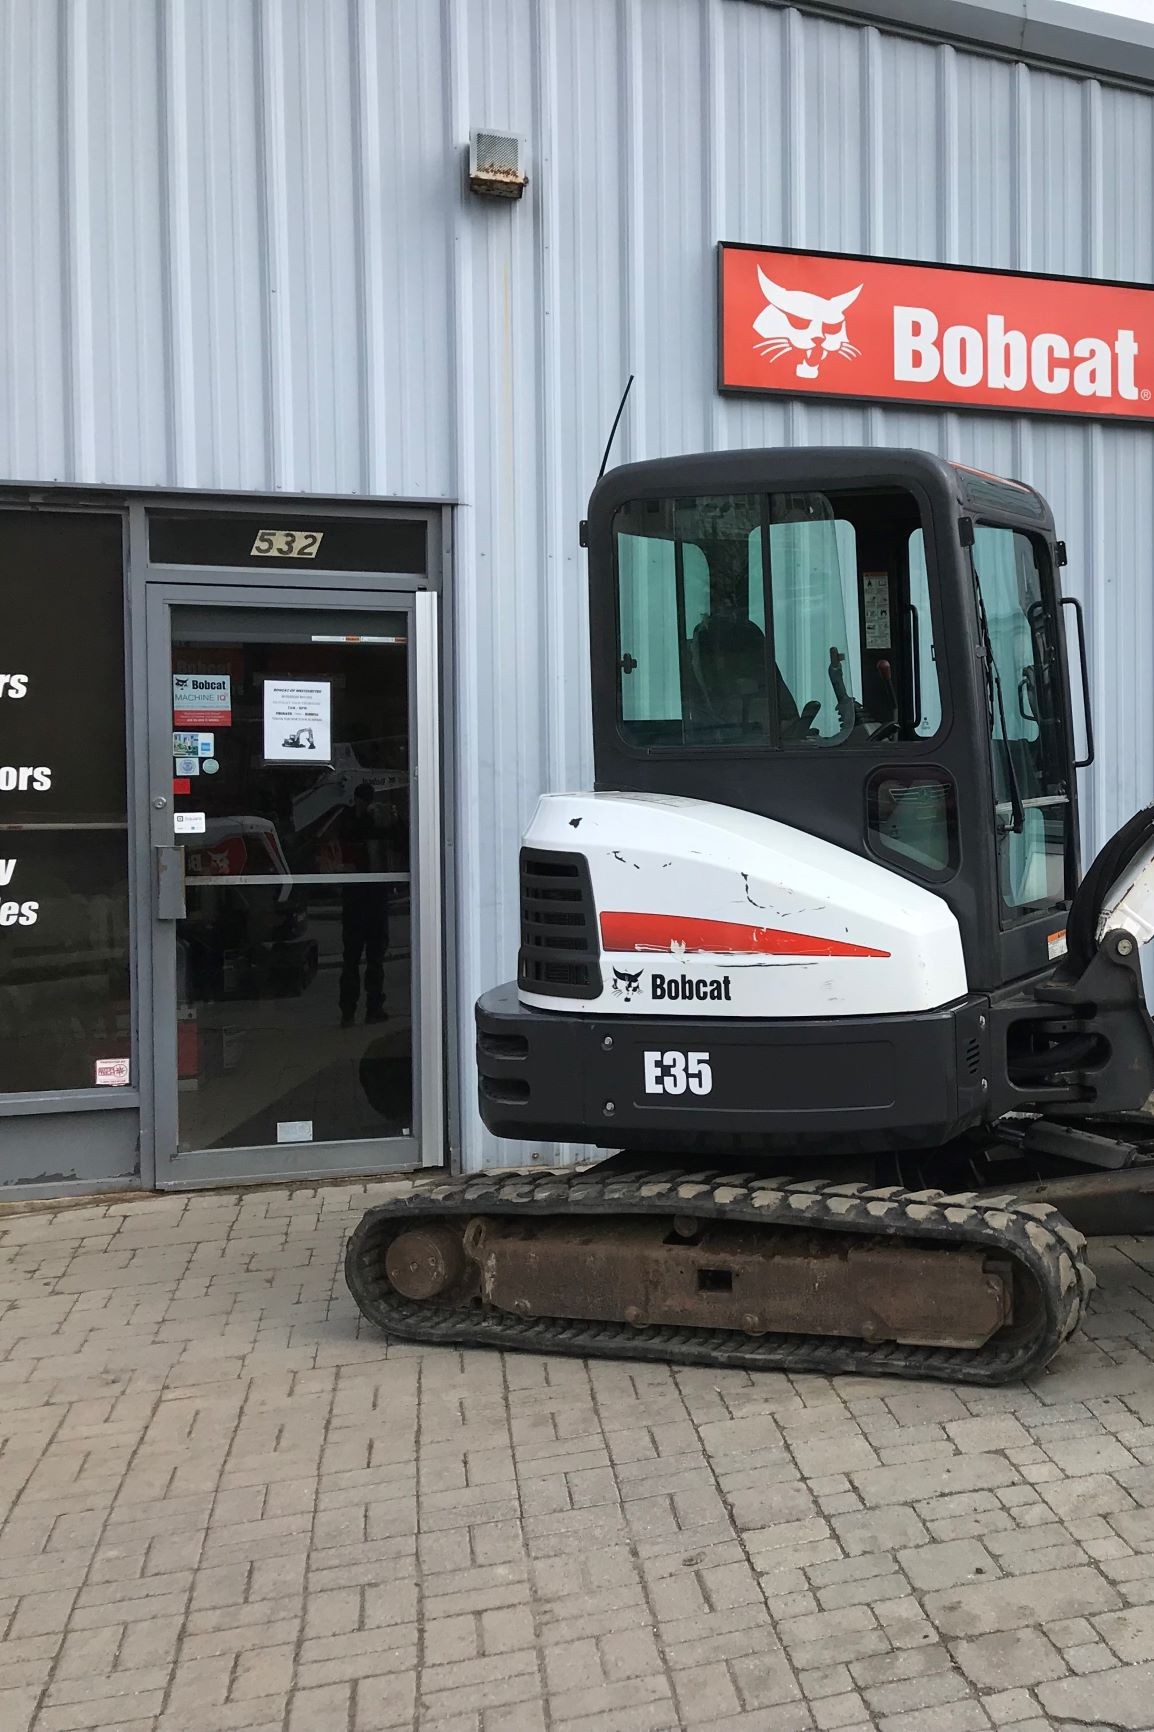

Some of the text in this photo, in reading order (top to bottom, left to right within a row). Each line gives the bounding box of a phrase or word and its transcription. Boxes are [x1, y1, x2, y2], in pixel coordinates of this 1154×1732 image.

[893, 305, 1139, 400] Bobcat
[255, 532, 317, 556] 532
[191, 680, 226, 690] Bobcat
[651, 974, 732, 1001] Bobcat
[643, 1050, 713, 1095] E35
